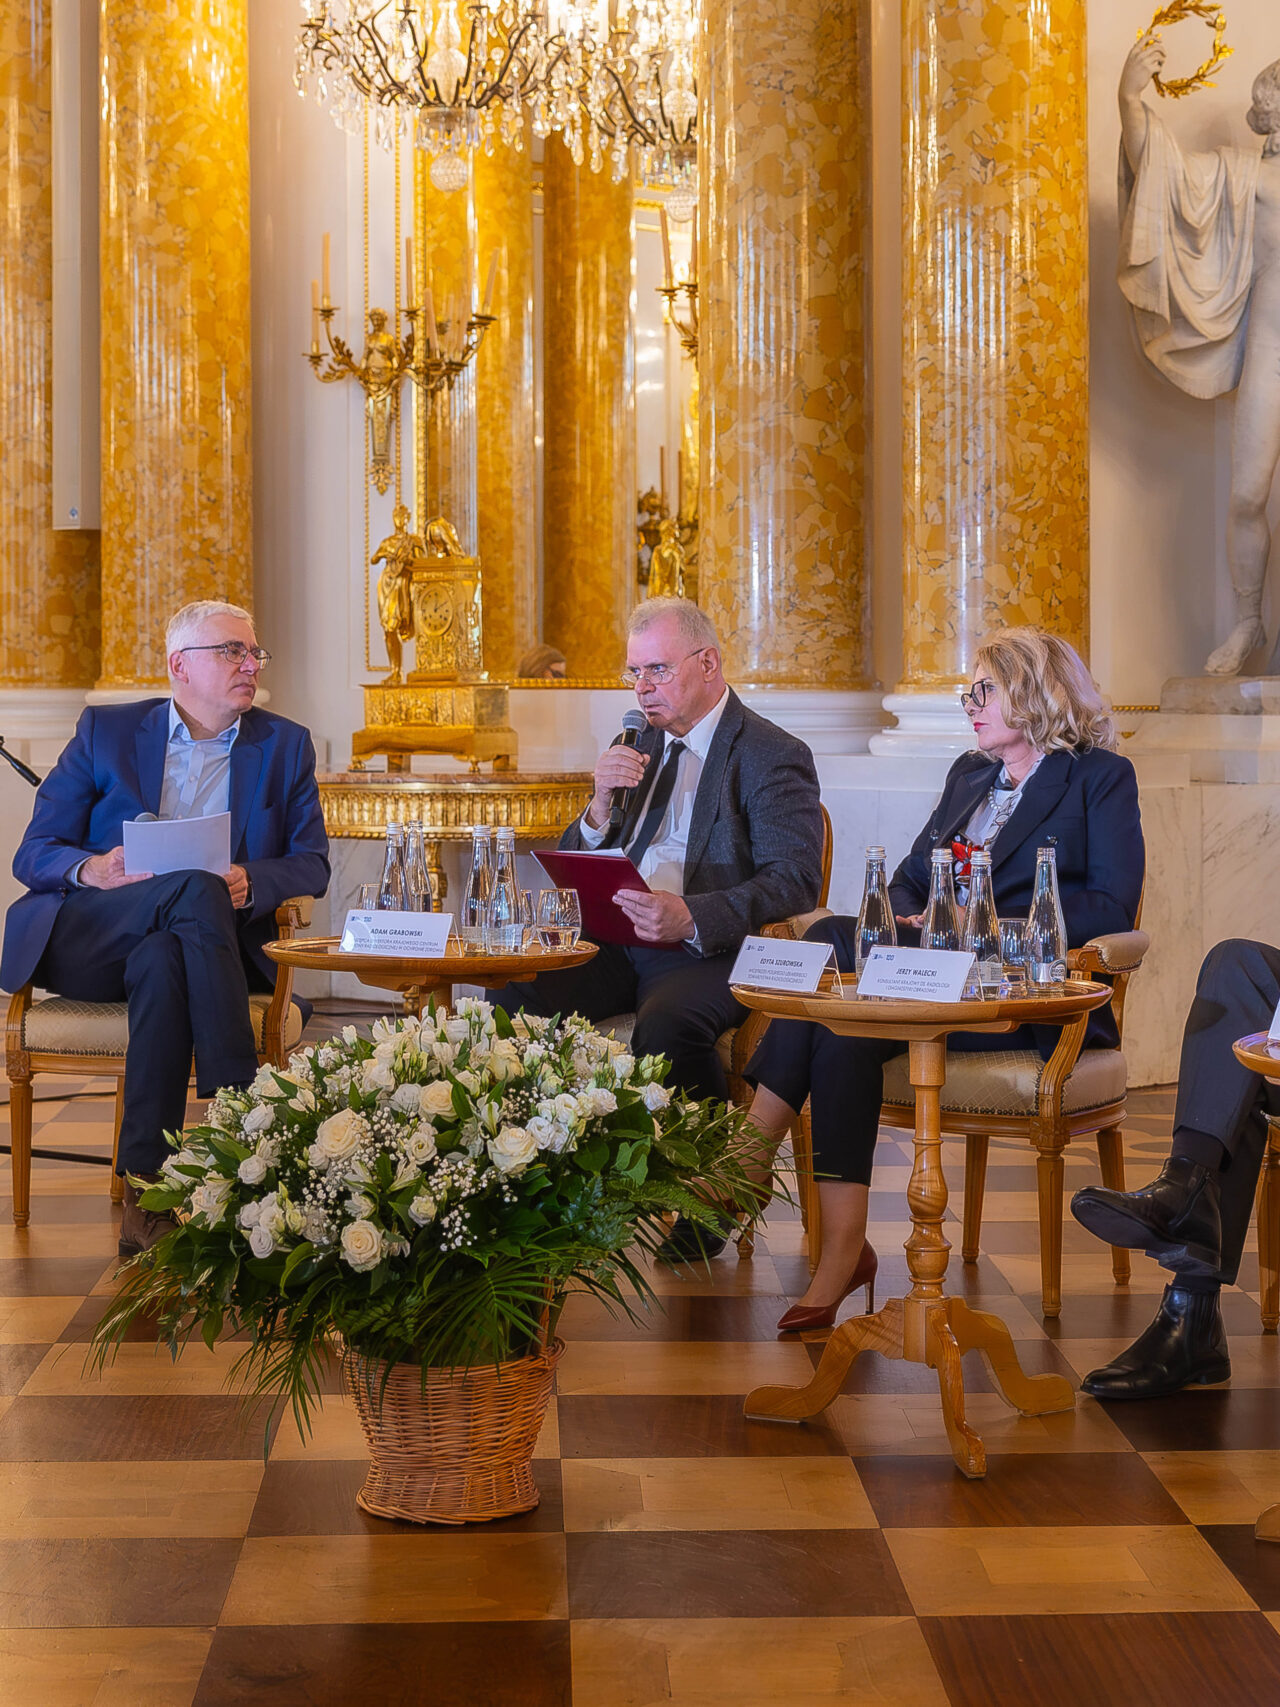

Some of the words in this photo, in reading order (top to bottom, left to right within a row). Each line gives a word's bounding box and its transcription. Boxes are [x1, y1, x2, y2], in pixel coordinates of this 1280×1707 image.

[370, 928, 388, 936] ADAM
[389, 929, 424, 937] GRABOWSKI
[912, 969, 938, 977] WALECKI
